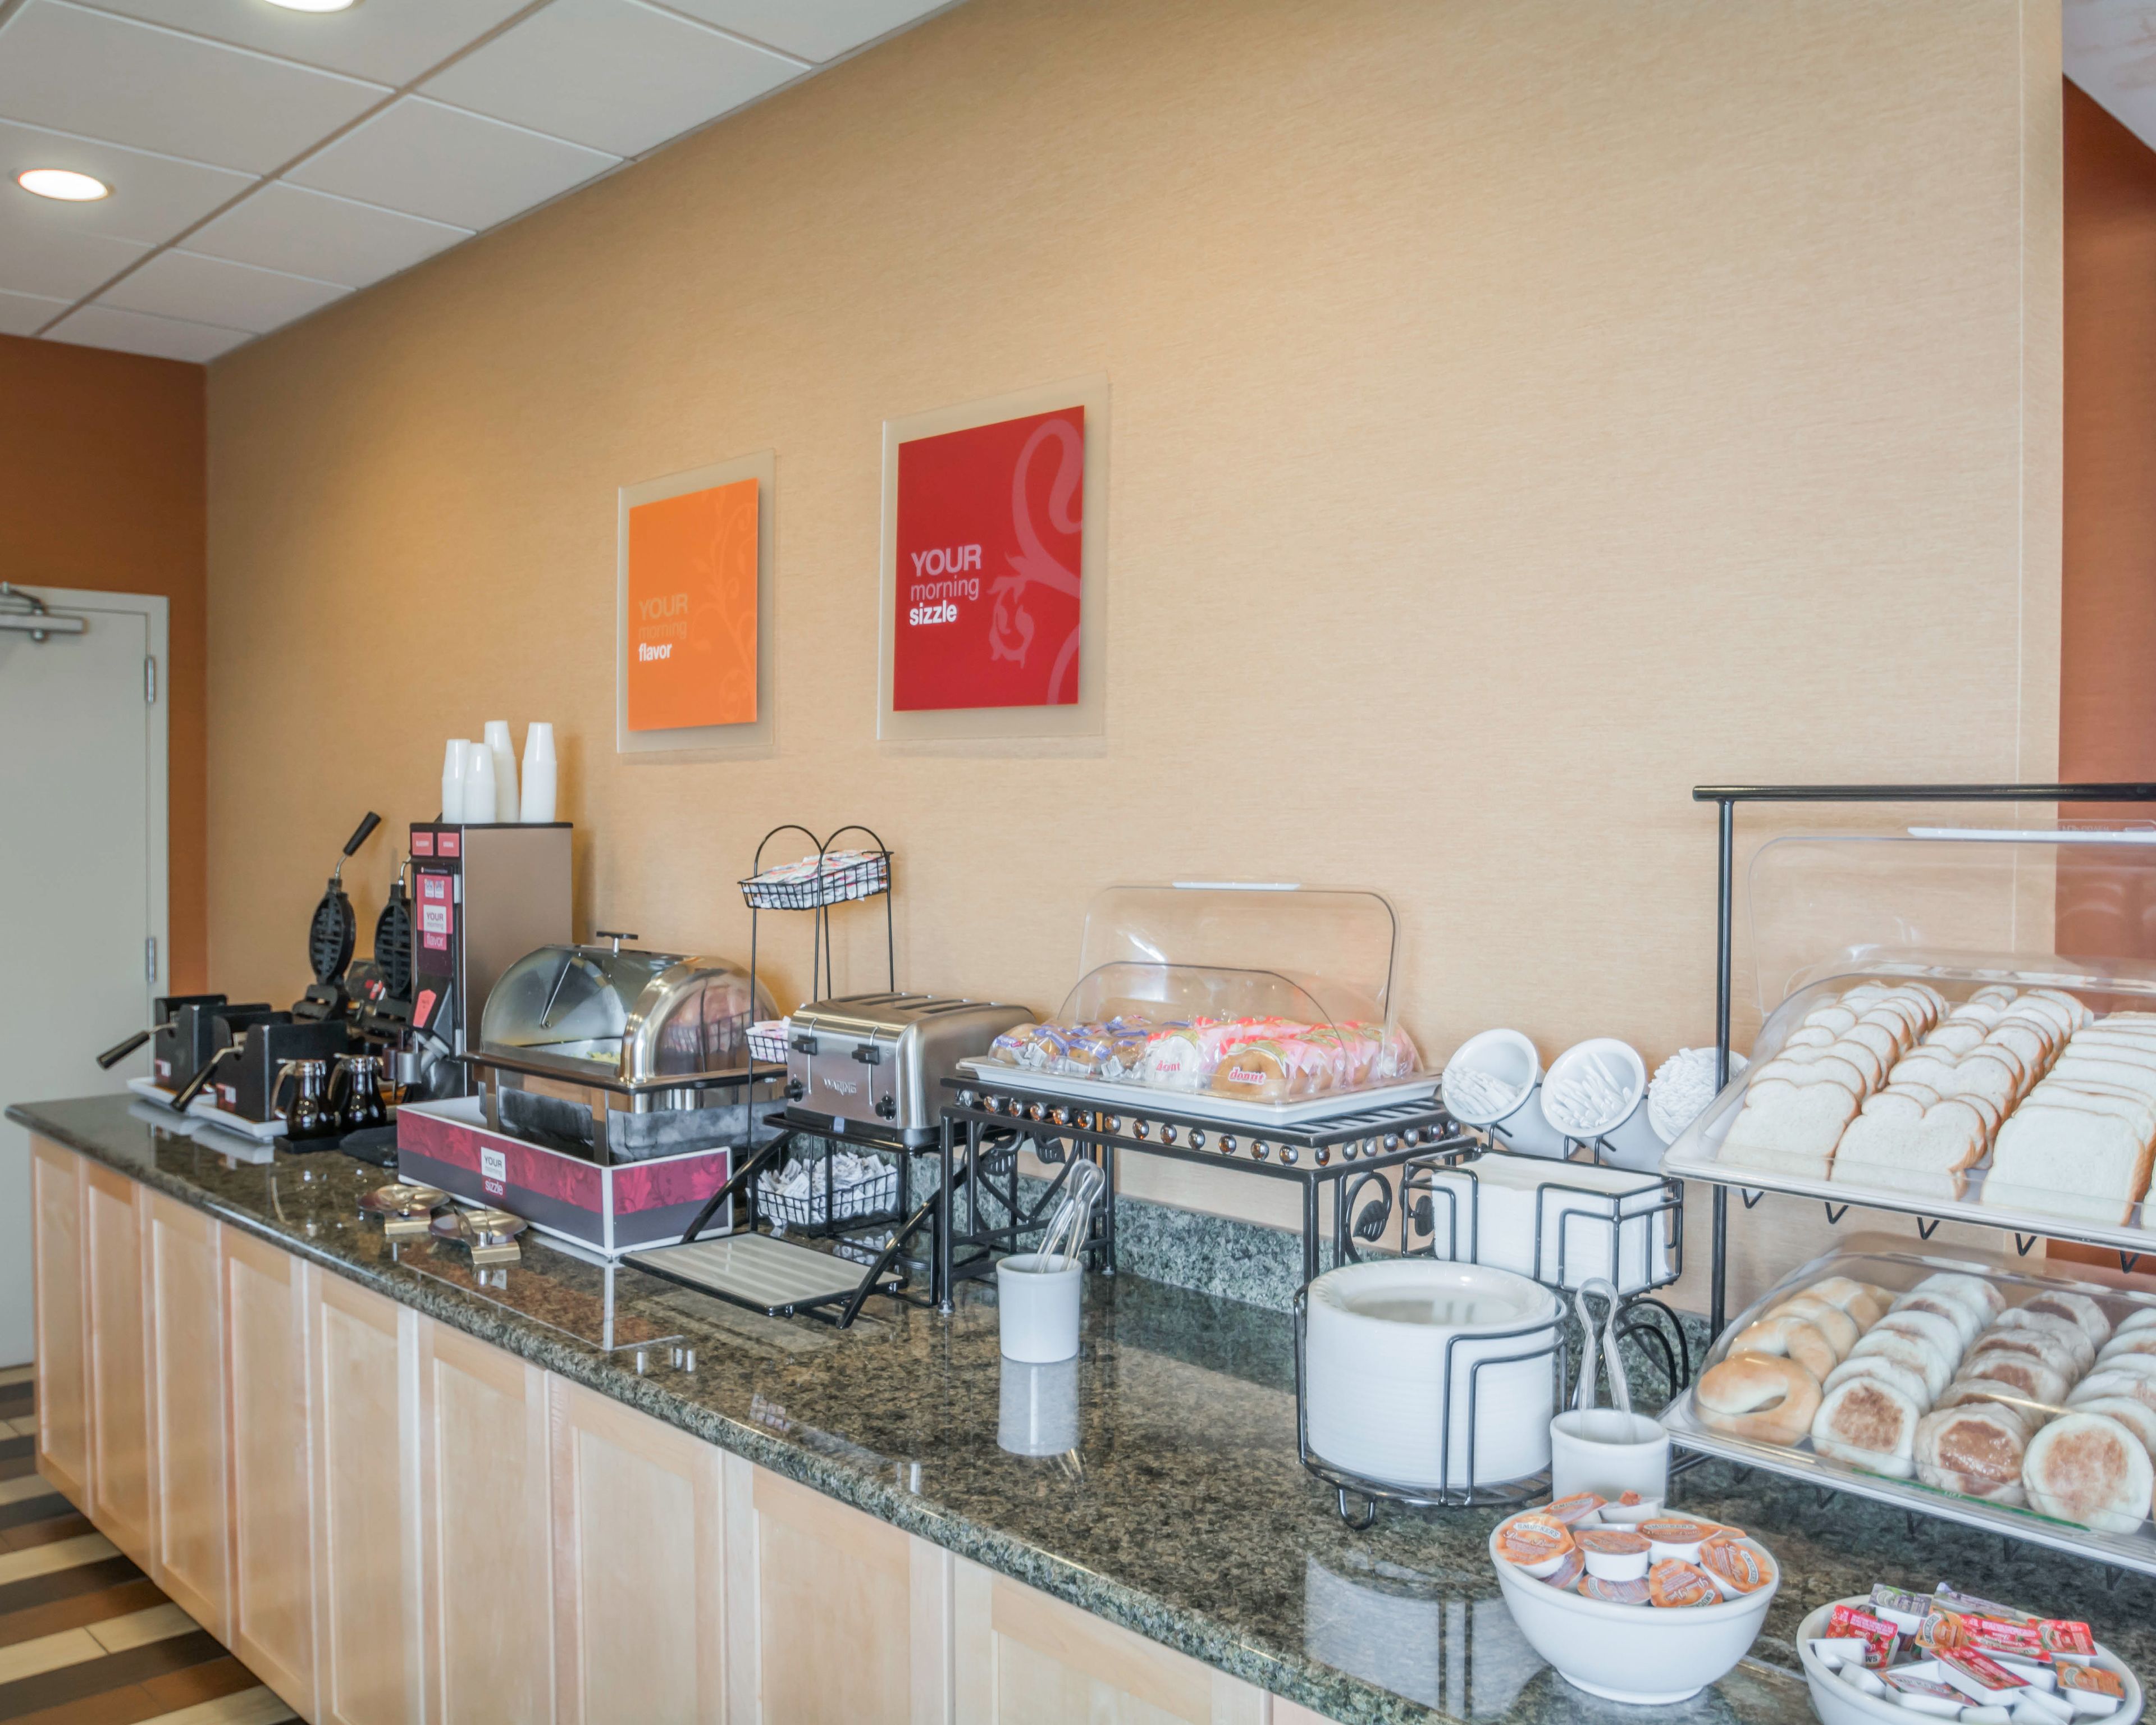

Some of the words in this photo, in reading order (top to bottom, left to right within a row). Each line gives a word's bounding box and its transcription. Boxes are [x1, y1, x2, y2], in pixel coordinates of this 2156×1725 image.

[911, 544, 982, 577] YOUR
[911, 575, 979, 601] morning
[638, 593, 688, 620] YOUR
[909, 599, 957, 626] sizzle
[638, 621, 687, 640] morning
[638, 642, 673, 661] flavor
[426, 912, 444, 921] YOUR
[427, 933, 444, 947] flavor
[1229, 1068, 1266, 1084] donut
[484, 1156, 503, 1168] YOUR
[485, 1179, 503, 1195] sizzle
